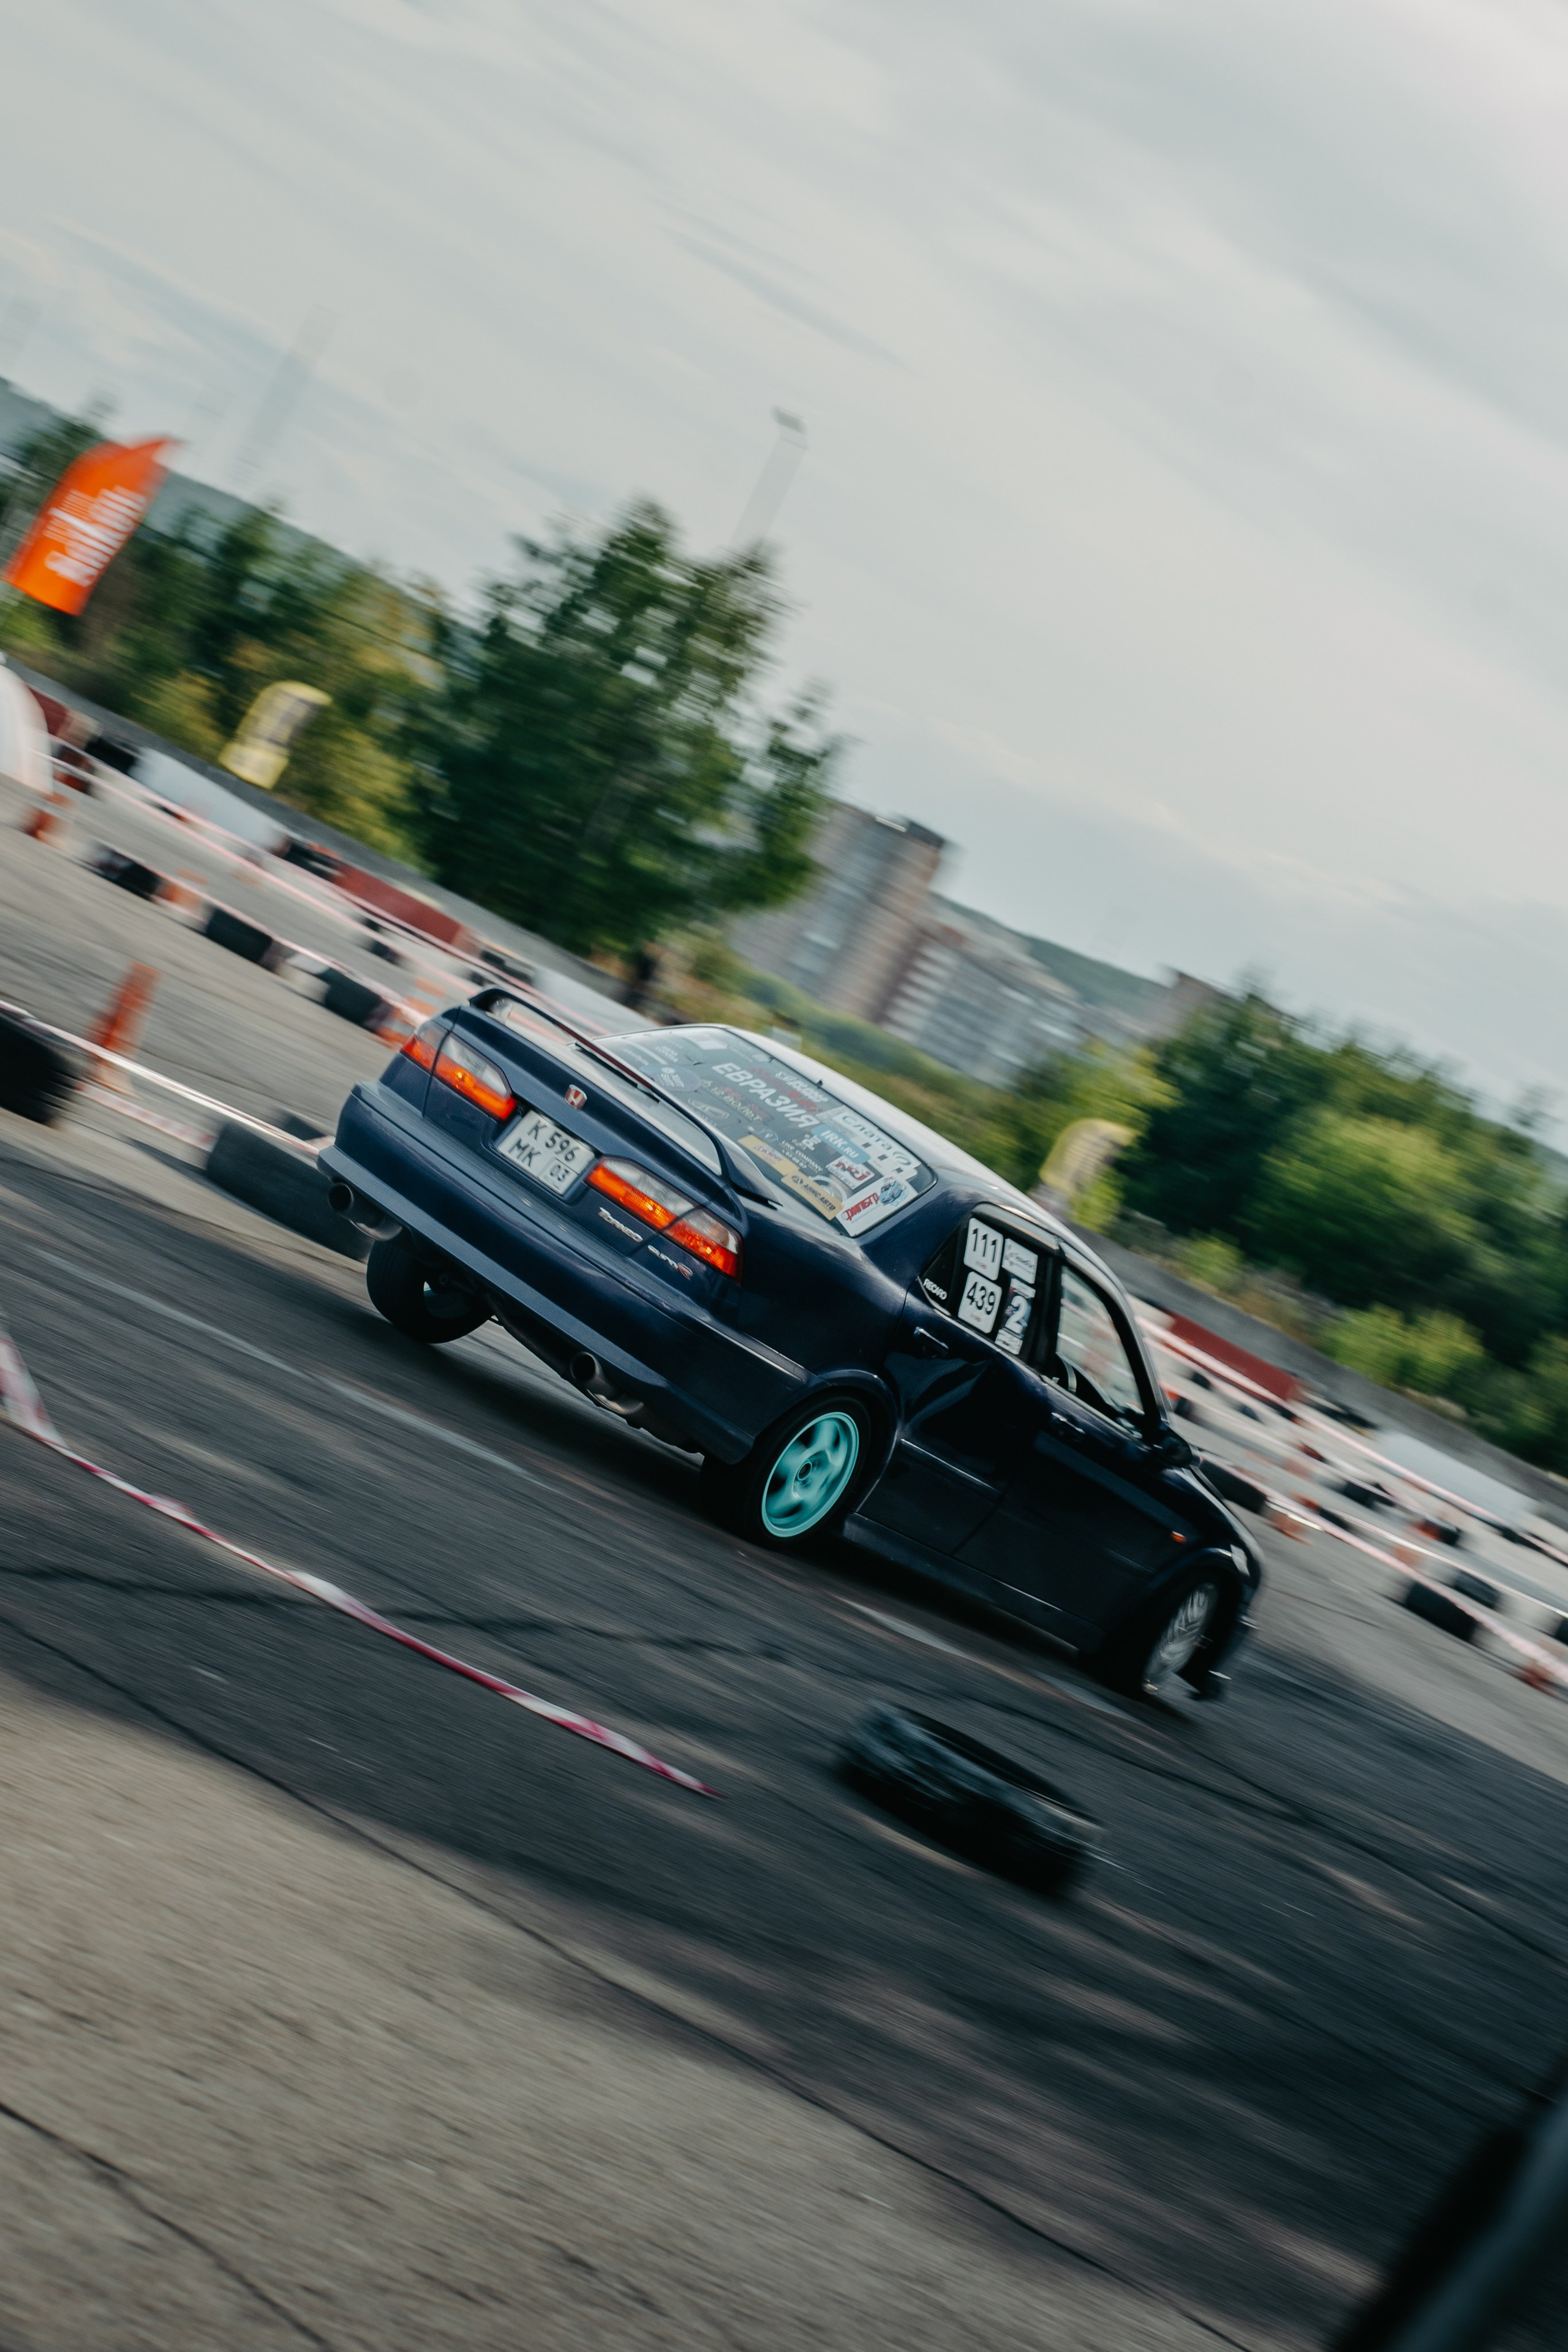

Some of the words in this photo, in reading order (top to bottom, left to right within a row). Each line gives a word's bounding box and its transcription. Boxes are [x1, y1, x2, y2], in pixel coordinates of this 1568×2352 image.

[711, 1063, 821, 1128] ЕВРАЗИЯ
[508, 1138, 543, 1167] МК
[550, 1164, 570, 1182] 03
[545, 1131, 581, 1161] 596
[821, 1129, 859, 1159] IRK.RU
[971, 1227, 997, 1263] 111
[923, 1278, 948, 1300] RECARO
[967, 1281, 997, 1316] 439
[1005, 1295, 1028, 1335] 2
